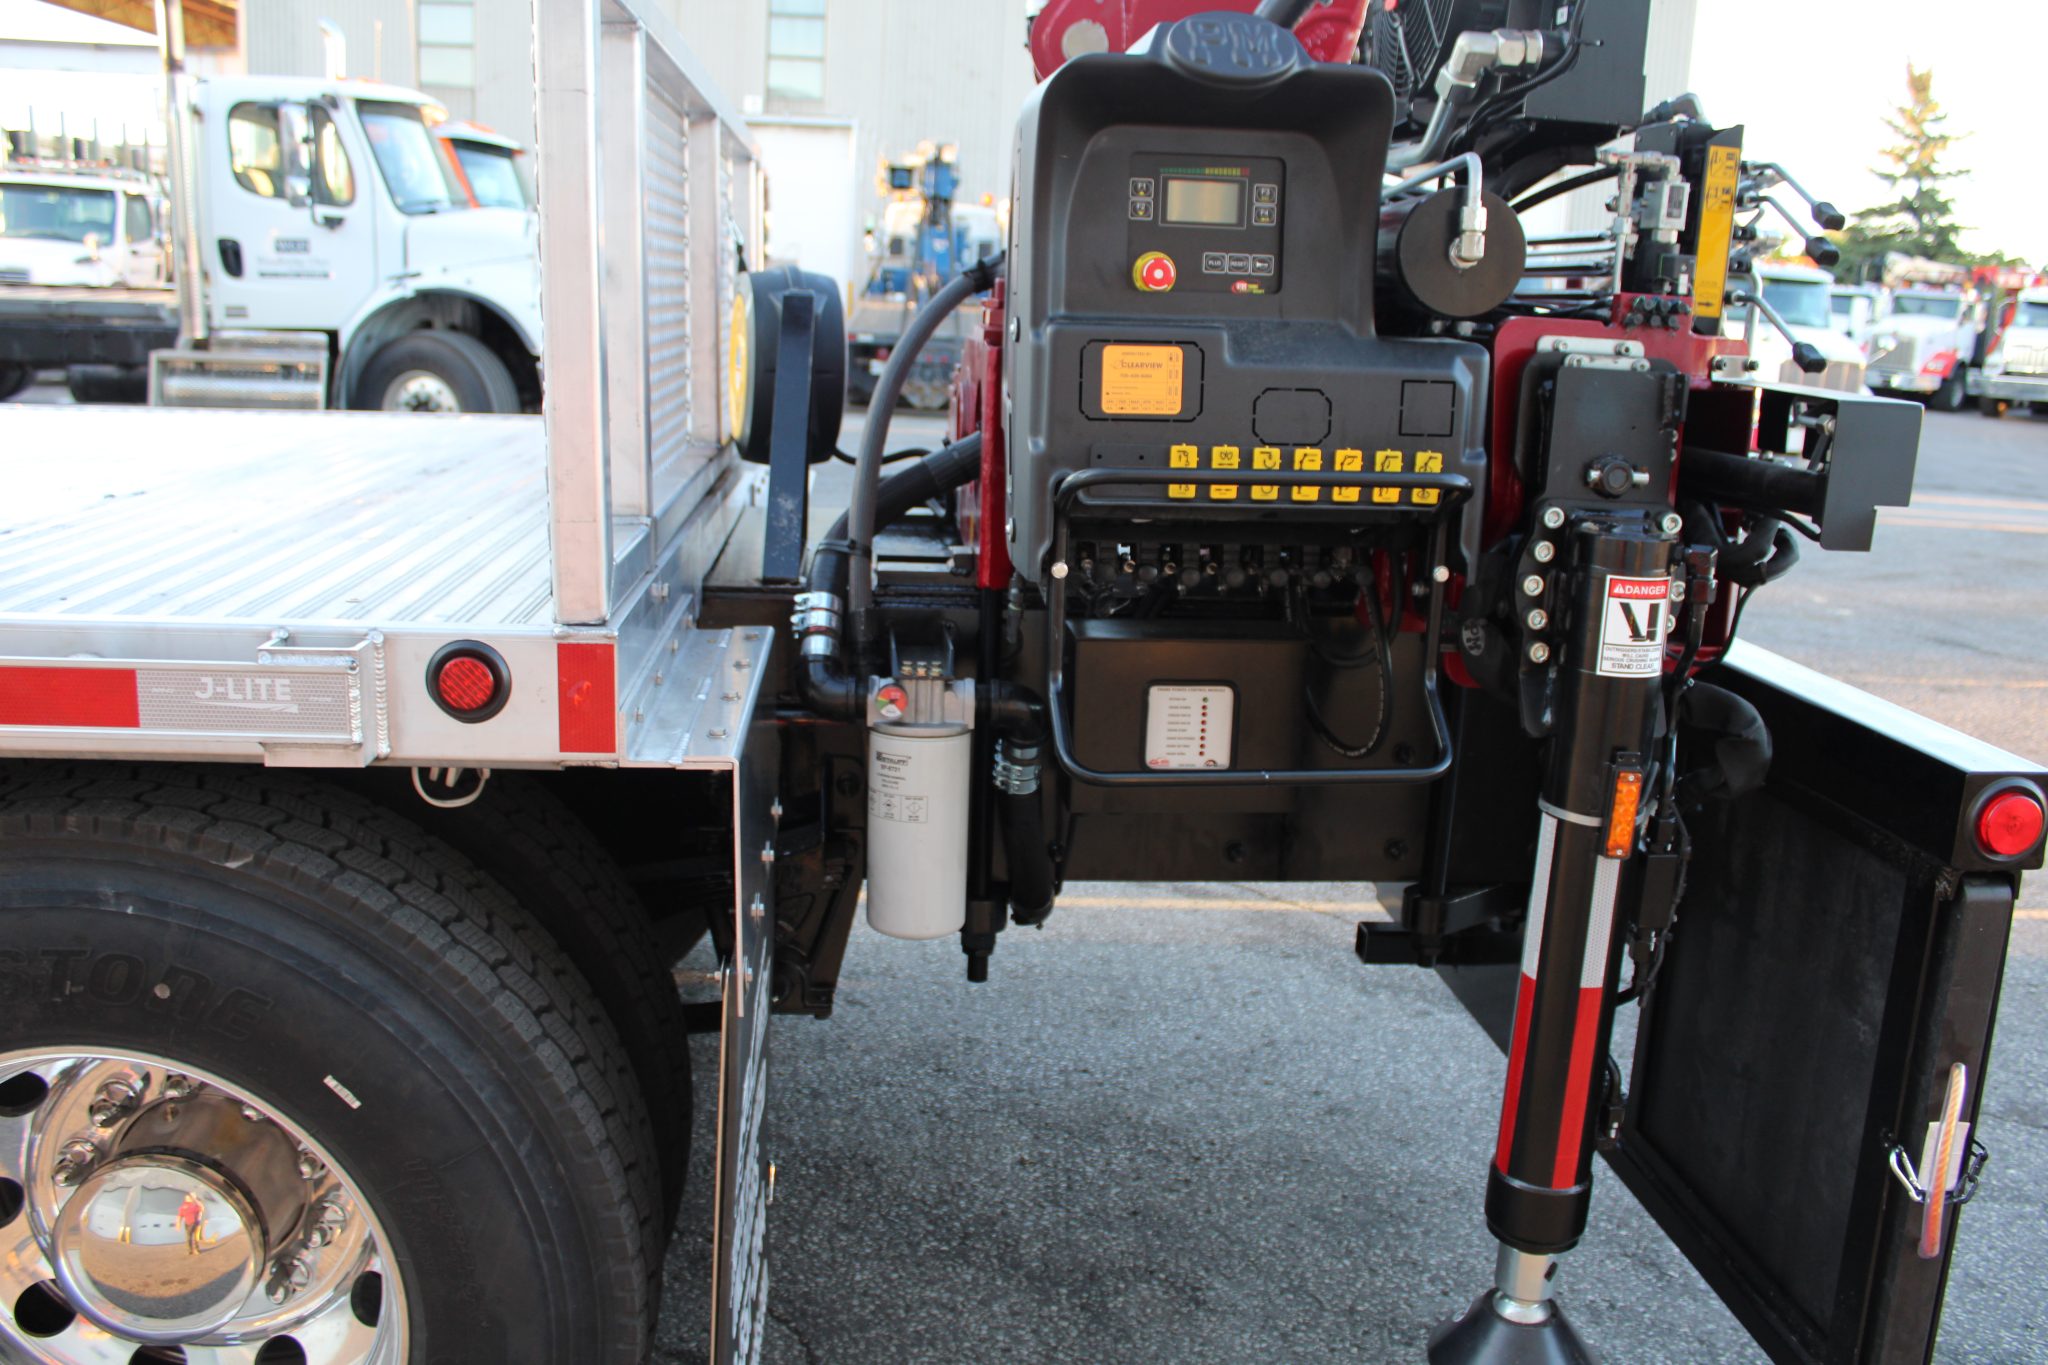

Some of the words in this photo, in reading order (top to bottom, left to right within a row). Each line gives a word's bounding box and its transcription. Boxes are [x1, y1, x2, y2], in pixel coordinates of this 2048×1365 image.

[1185, 19, 1283, 68] PM
[1121, 359, 1163, 369] CLEARVIEW
[1624, 585, 1666, 595] DANGER
[195, 676, 292, 701] J-LITE
